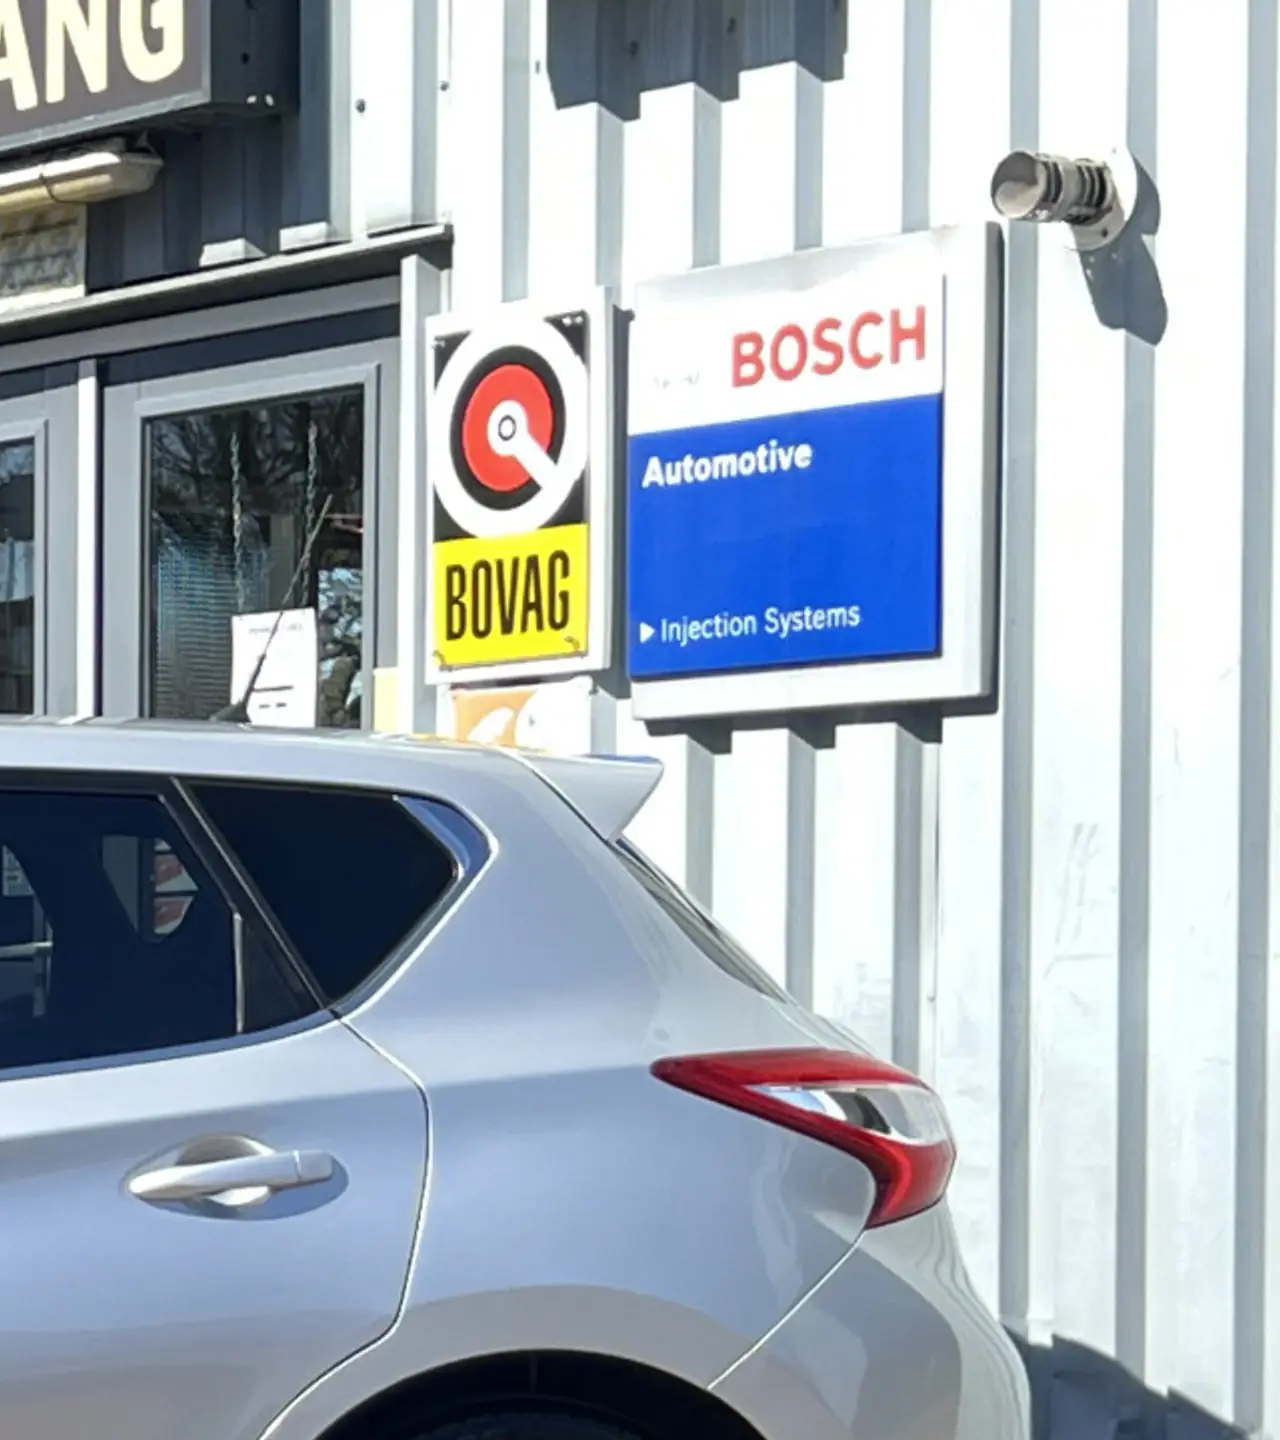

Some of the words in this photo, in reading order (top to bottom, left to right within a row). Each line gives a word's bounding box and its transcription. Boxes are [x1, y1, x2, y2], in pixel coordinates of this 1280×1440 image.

[732, 305, 927, 387] BOSCH
[642, 439, 813, 488] Automotive
[446, 549, 570, 641] BOVAG
[661, 611, 757, 647] Injection
[764, 605, 860, 638] Systems
